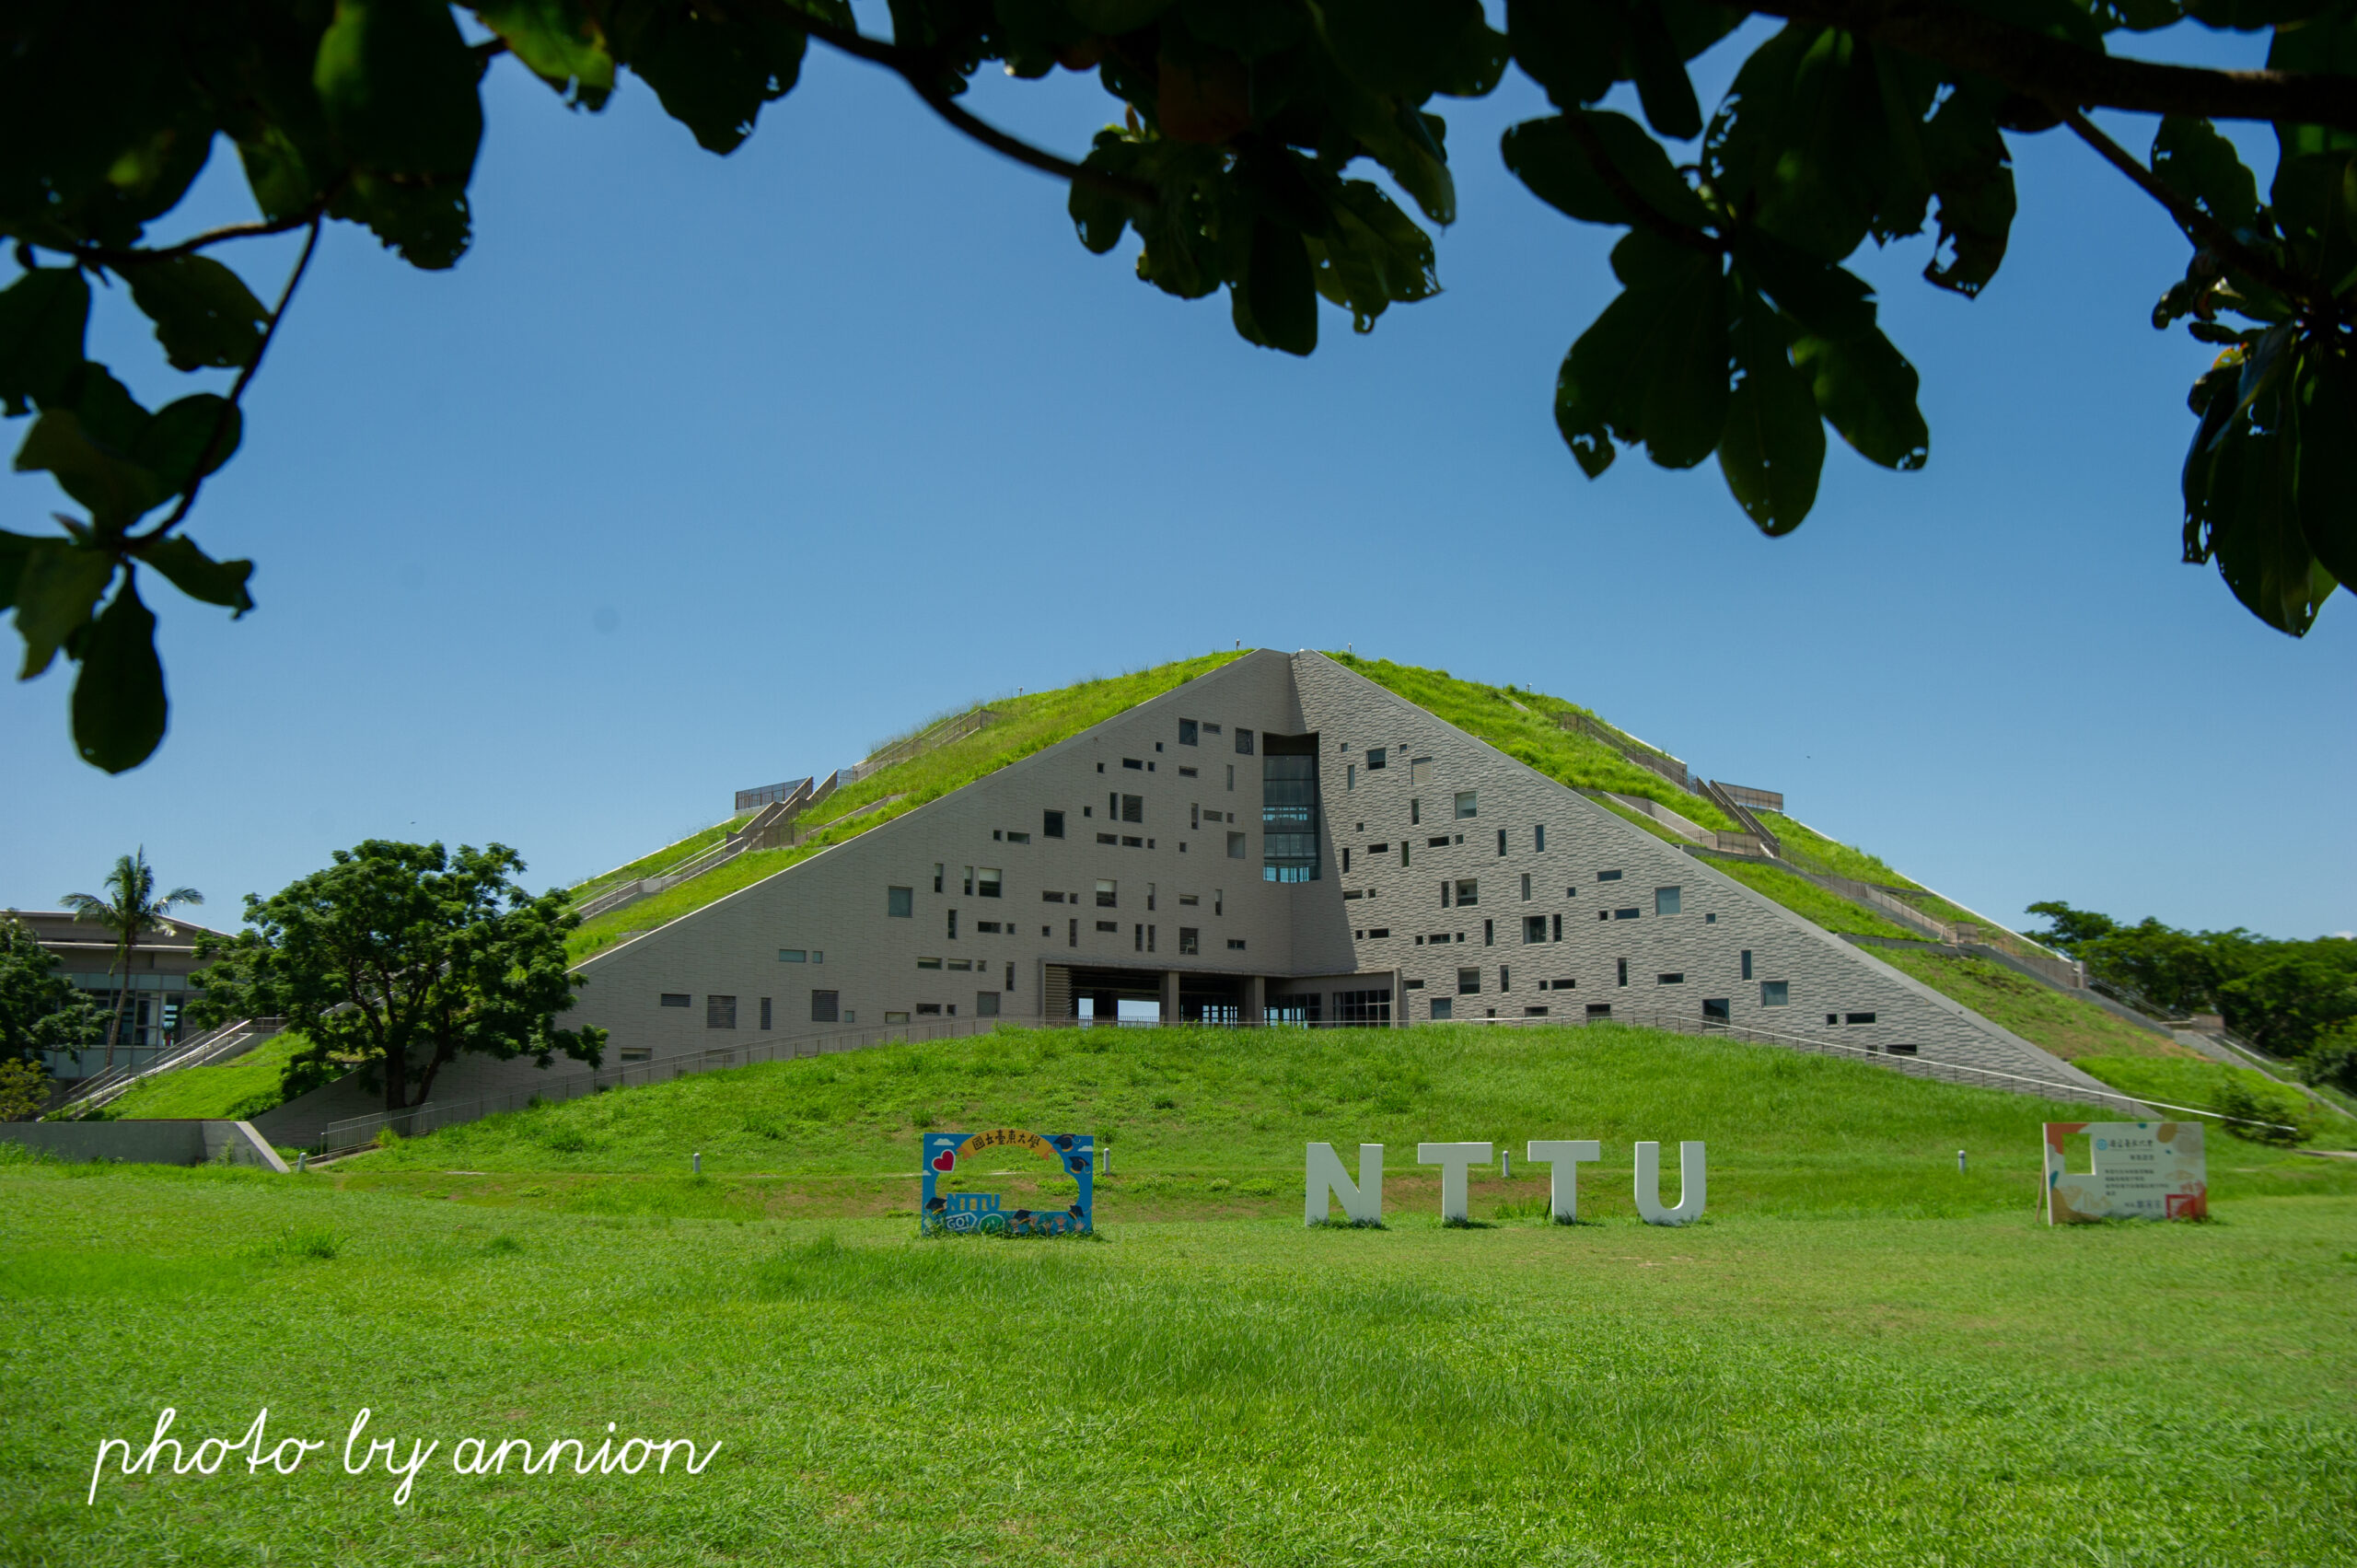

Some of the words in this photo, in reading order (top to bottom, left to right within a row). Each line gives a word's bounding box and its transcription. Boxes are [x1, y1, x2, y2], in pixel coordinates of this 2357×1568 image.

[972, 1129, 1041, 1151] 國立臺東大學
[1305, 1140, 1707, 1227] NTTU
[946, 1193, 1001, 1212] NTTU
[946, 1215, 970, 1229] GO!
